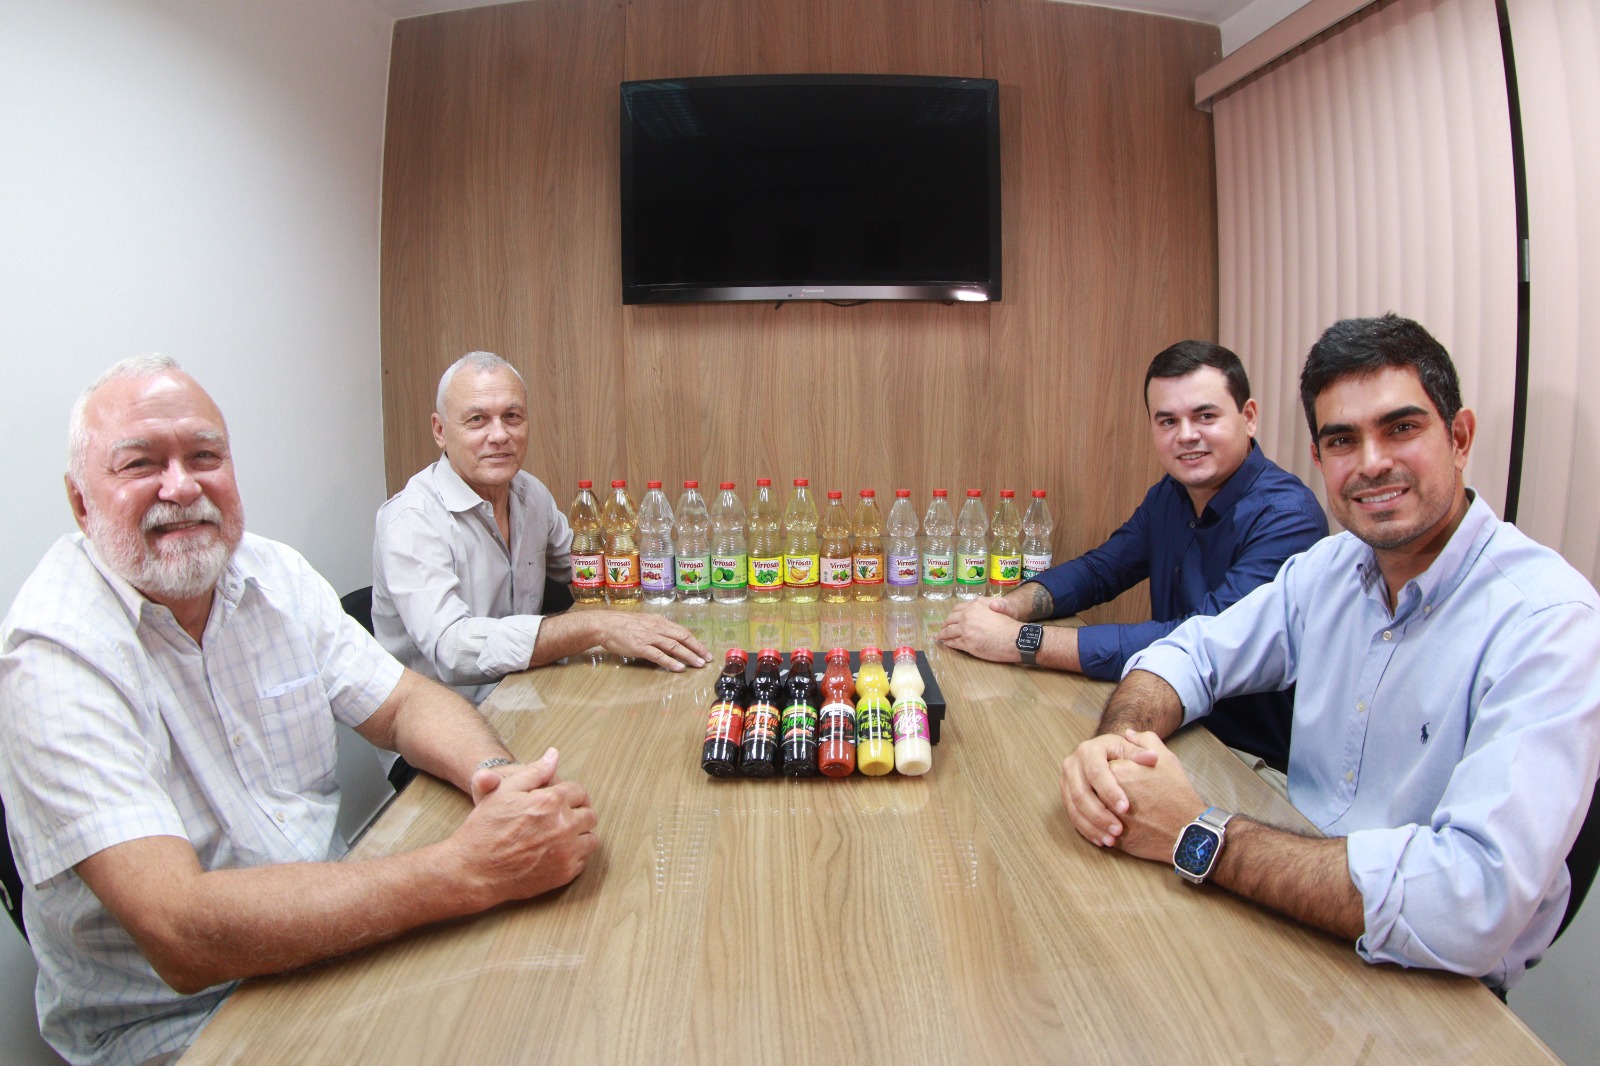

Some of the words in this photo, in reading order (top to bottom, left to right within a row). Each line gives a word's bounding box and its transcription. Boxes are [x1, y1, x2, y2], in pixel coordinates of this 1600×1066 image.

[573, 558, 598, 566] Virrosas
[606, 558, 631, 567] Virrosas
[678, 560, 704, 568] Virrosas
[712, 558, 736, 567] Virrosas
[753, 561, 779, 569] Virrosas
[787, 558, 812, 566] Virrosas
[855, 557, 878, 566] Virrosas
[926, 558, 950, 566] Virrosas
[860, 720, 891, 732] PIMENTA
